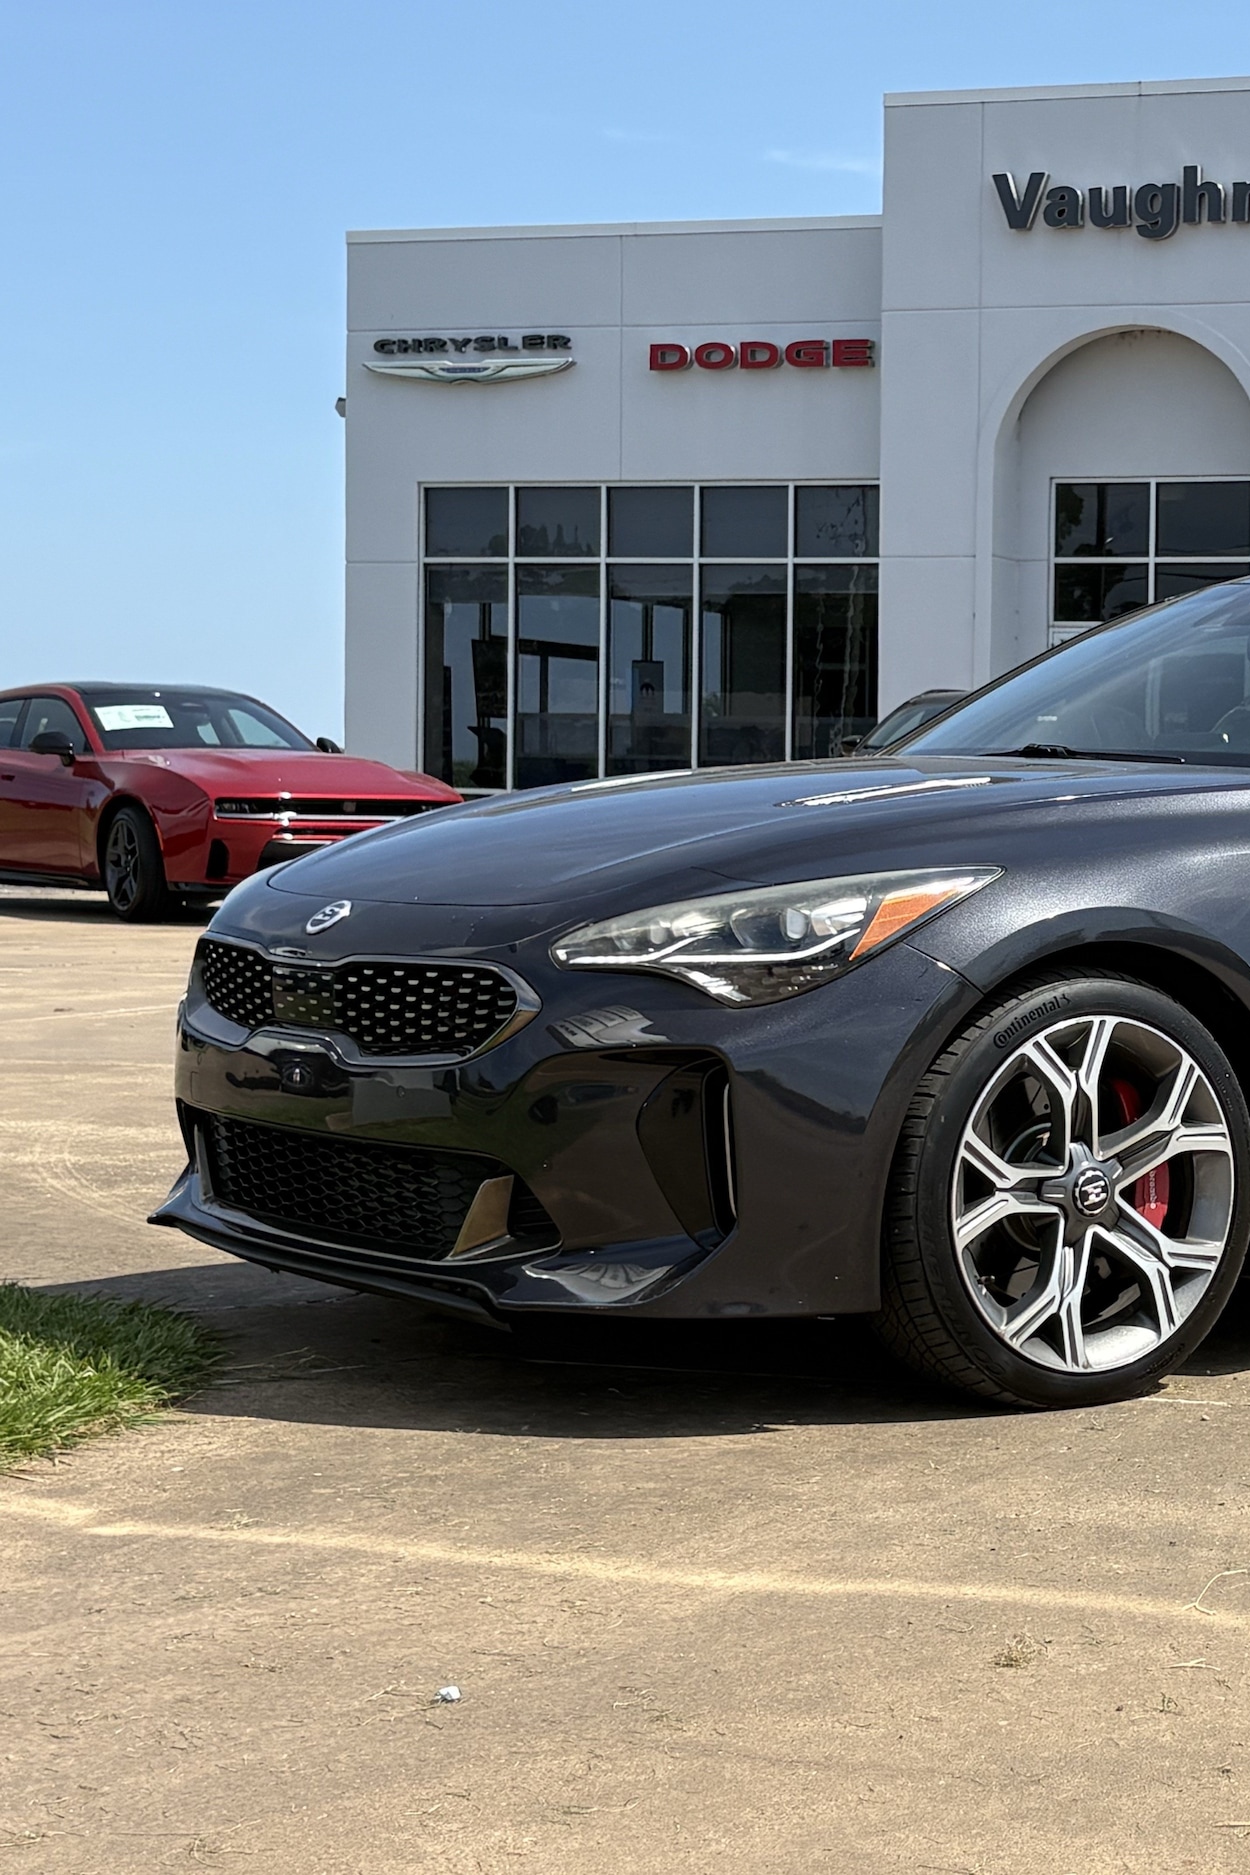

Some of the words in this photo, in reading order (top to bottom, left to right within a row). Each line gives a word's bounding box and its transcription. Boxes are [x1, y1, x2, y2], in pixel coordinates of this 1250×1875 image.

[373, 334, 572, 354] CHRYSLER
[649, 339, 876, 371] DODGE
[993, 995, 1062, 1049] Continental
